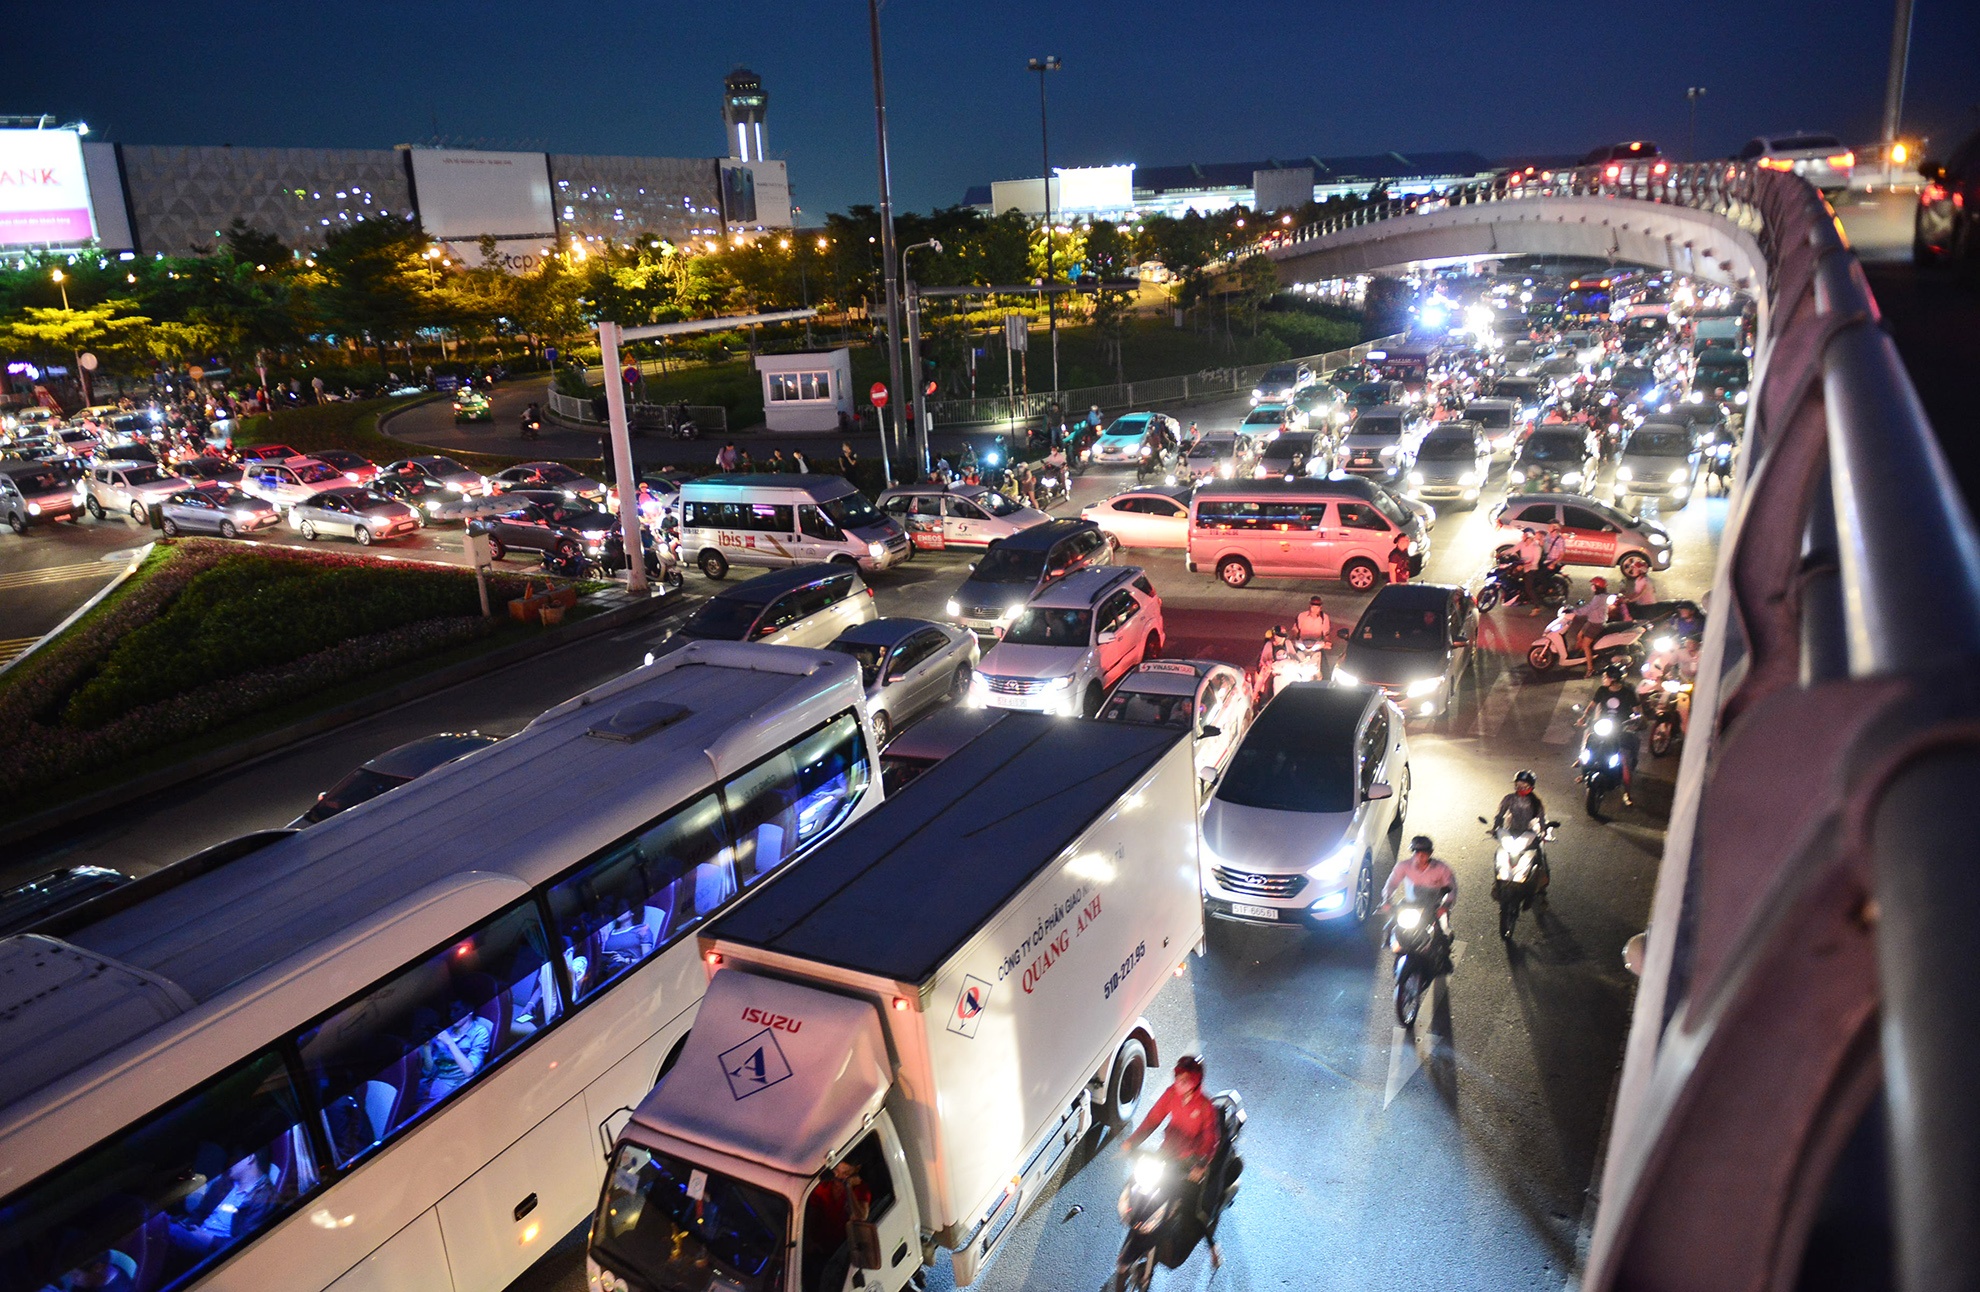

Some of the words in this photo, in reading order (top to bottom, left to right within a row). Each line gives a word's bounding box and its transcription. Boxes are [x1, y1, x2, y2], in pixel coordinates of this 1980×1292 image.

[718, 531, 742, 547] ibis
[917, 534, 943, 542] ENEOS
[1574, 540, 1615, 551] GENERALI
[1021, 935, 1032, 958] TY
[1064, 888, 1082, 914] GIAO
[1022, 929, 1070, 995] QUANG
[1075, 892, 1102, 938] ANH
[741, 1006, 803, 1034] ISUZU
